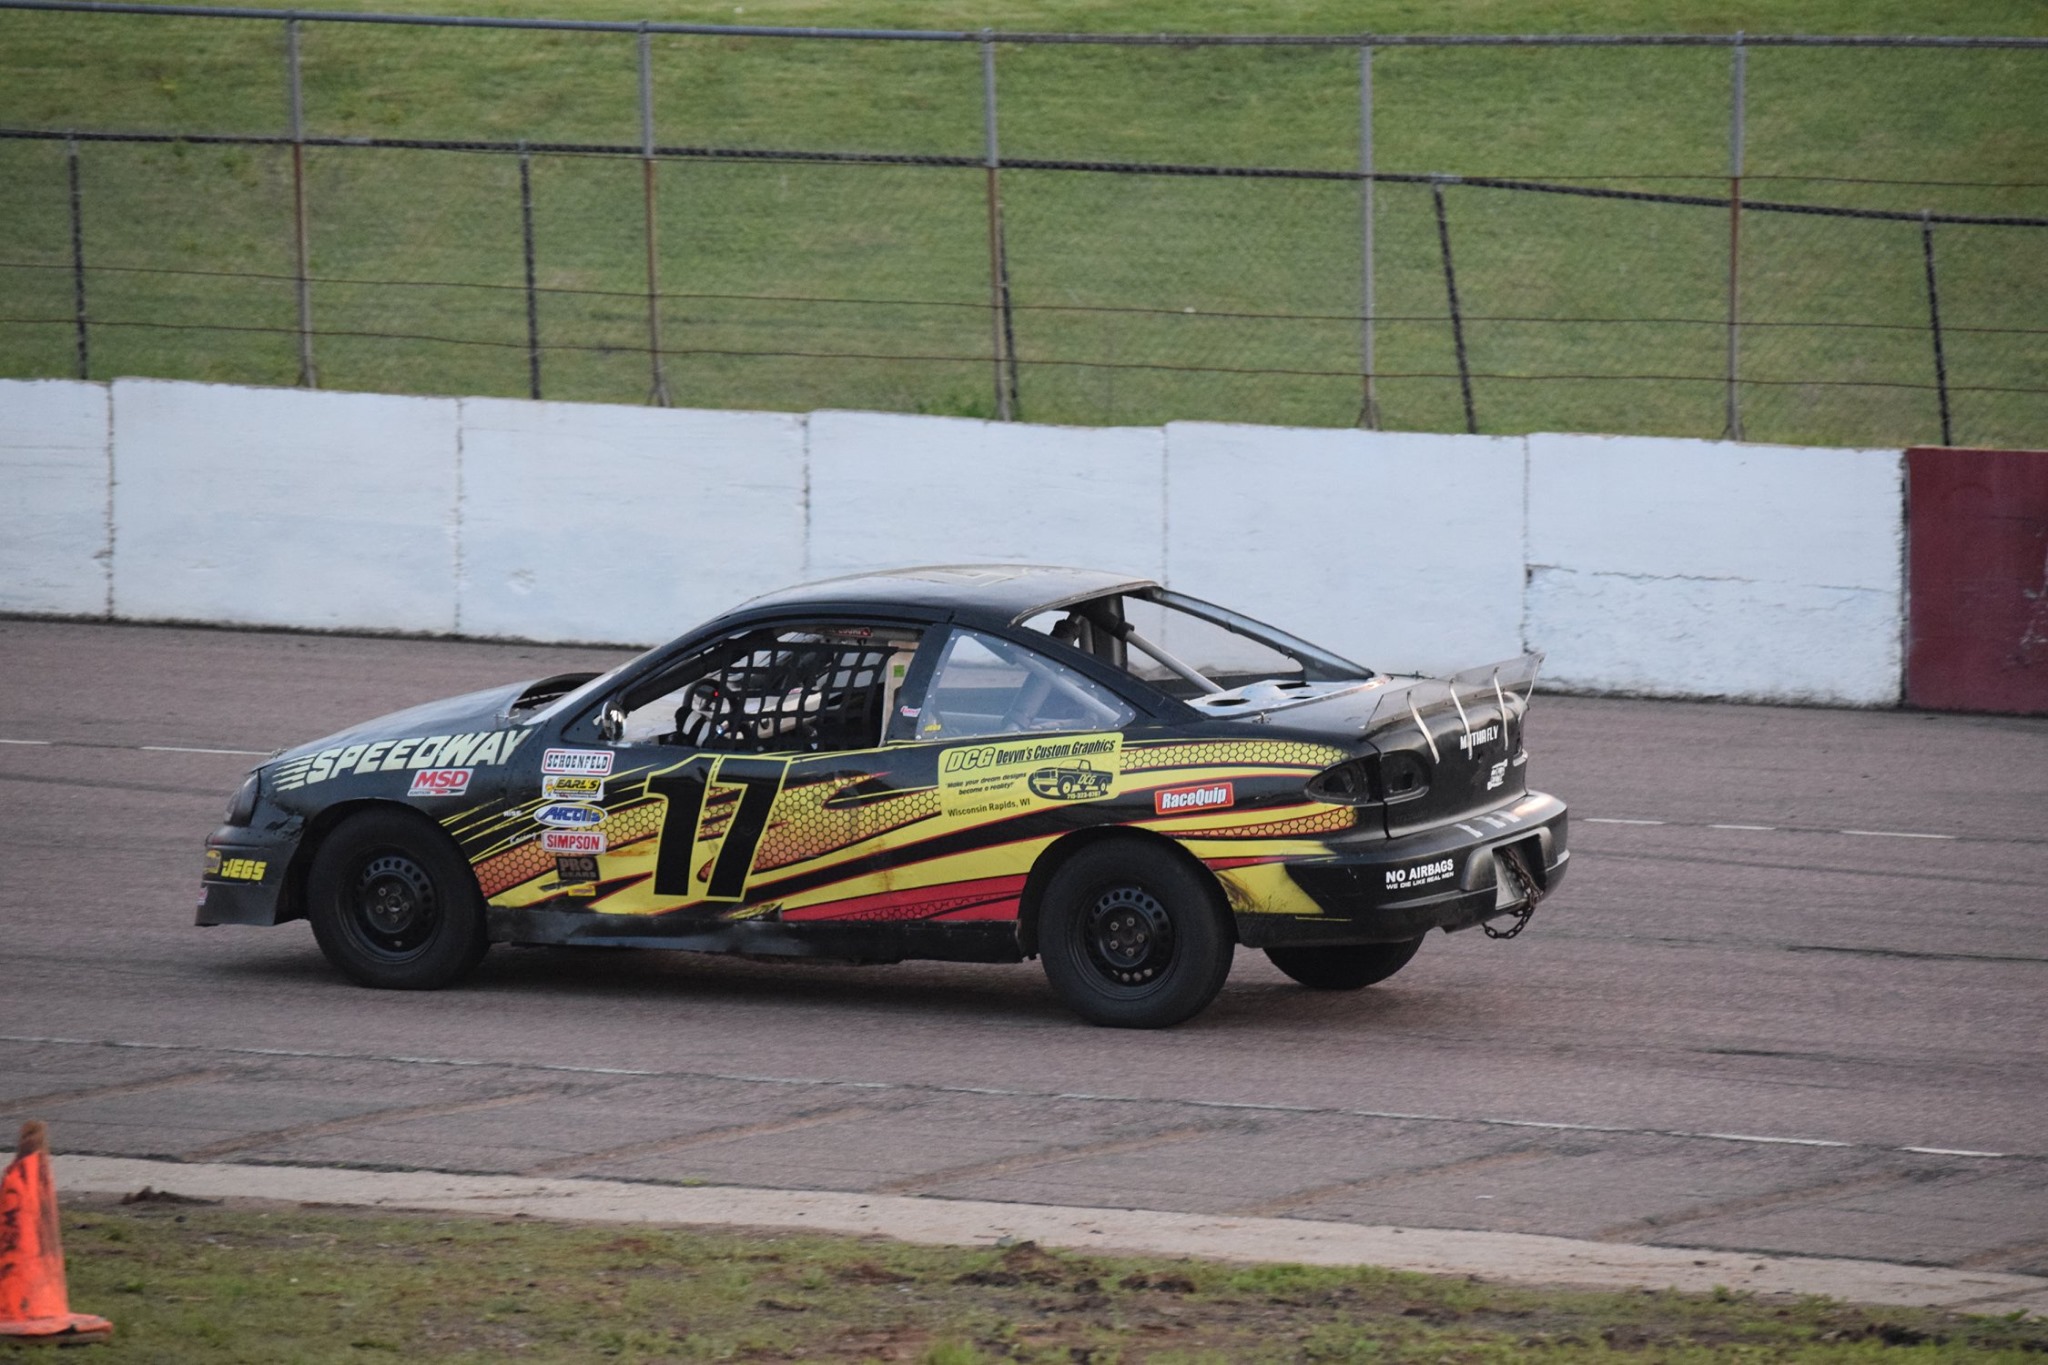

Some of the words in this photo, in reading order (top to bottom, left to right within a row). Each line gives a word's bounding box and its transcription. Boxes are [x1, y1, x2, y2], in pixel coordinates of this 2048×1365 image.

[306, 728, 532, 784] SPEEDWAY
[547, 754, 609, 769] SCHOENFELD
[945, 747, 996, 773] DCG
[996, 747, 1033, 764] Devyn's
[1033, 743, 1071, 759] Custom
[1071, 739, 1116, 755] Graphics
[413, 770, 469, 788] MSD
[555, 779, 599, 790] EARL'S
[980, 776, 1001, 784] dream
[1002, 772, 1027, 780] designs
[1077, 773, 1098, 786] DCG
[958, 786, 983, 796] become
[1161, 787, 1227, 810] RaceQuip
[947, 804, 988, 817] Wisconsin
[988, 799, 1019, 812] Rapids,
[1019, 797, 1031, 807] WI
[643, 753, 794, 902] 17
[547, 834, 600, 850] SIMPSON
[221, 858, 268, 881] JEGS
[560, 857, 594, 872] PRO
[1385, 869, 1406, 884] NO
[1408, 858, 1454, 881] AIRBAGS
[1400, 881, 1411, 889] DIE
[1427, 875, 1441, 883] REAL
[1442, 871, 1454, 880] MEN
